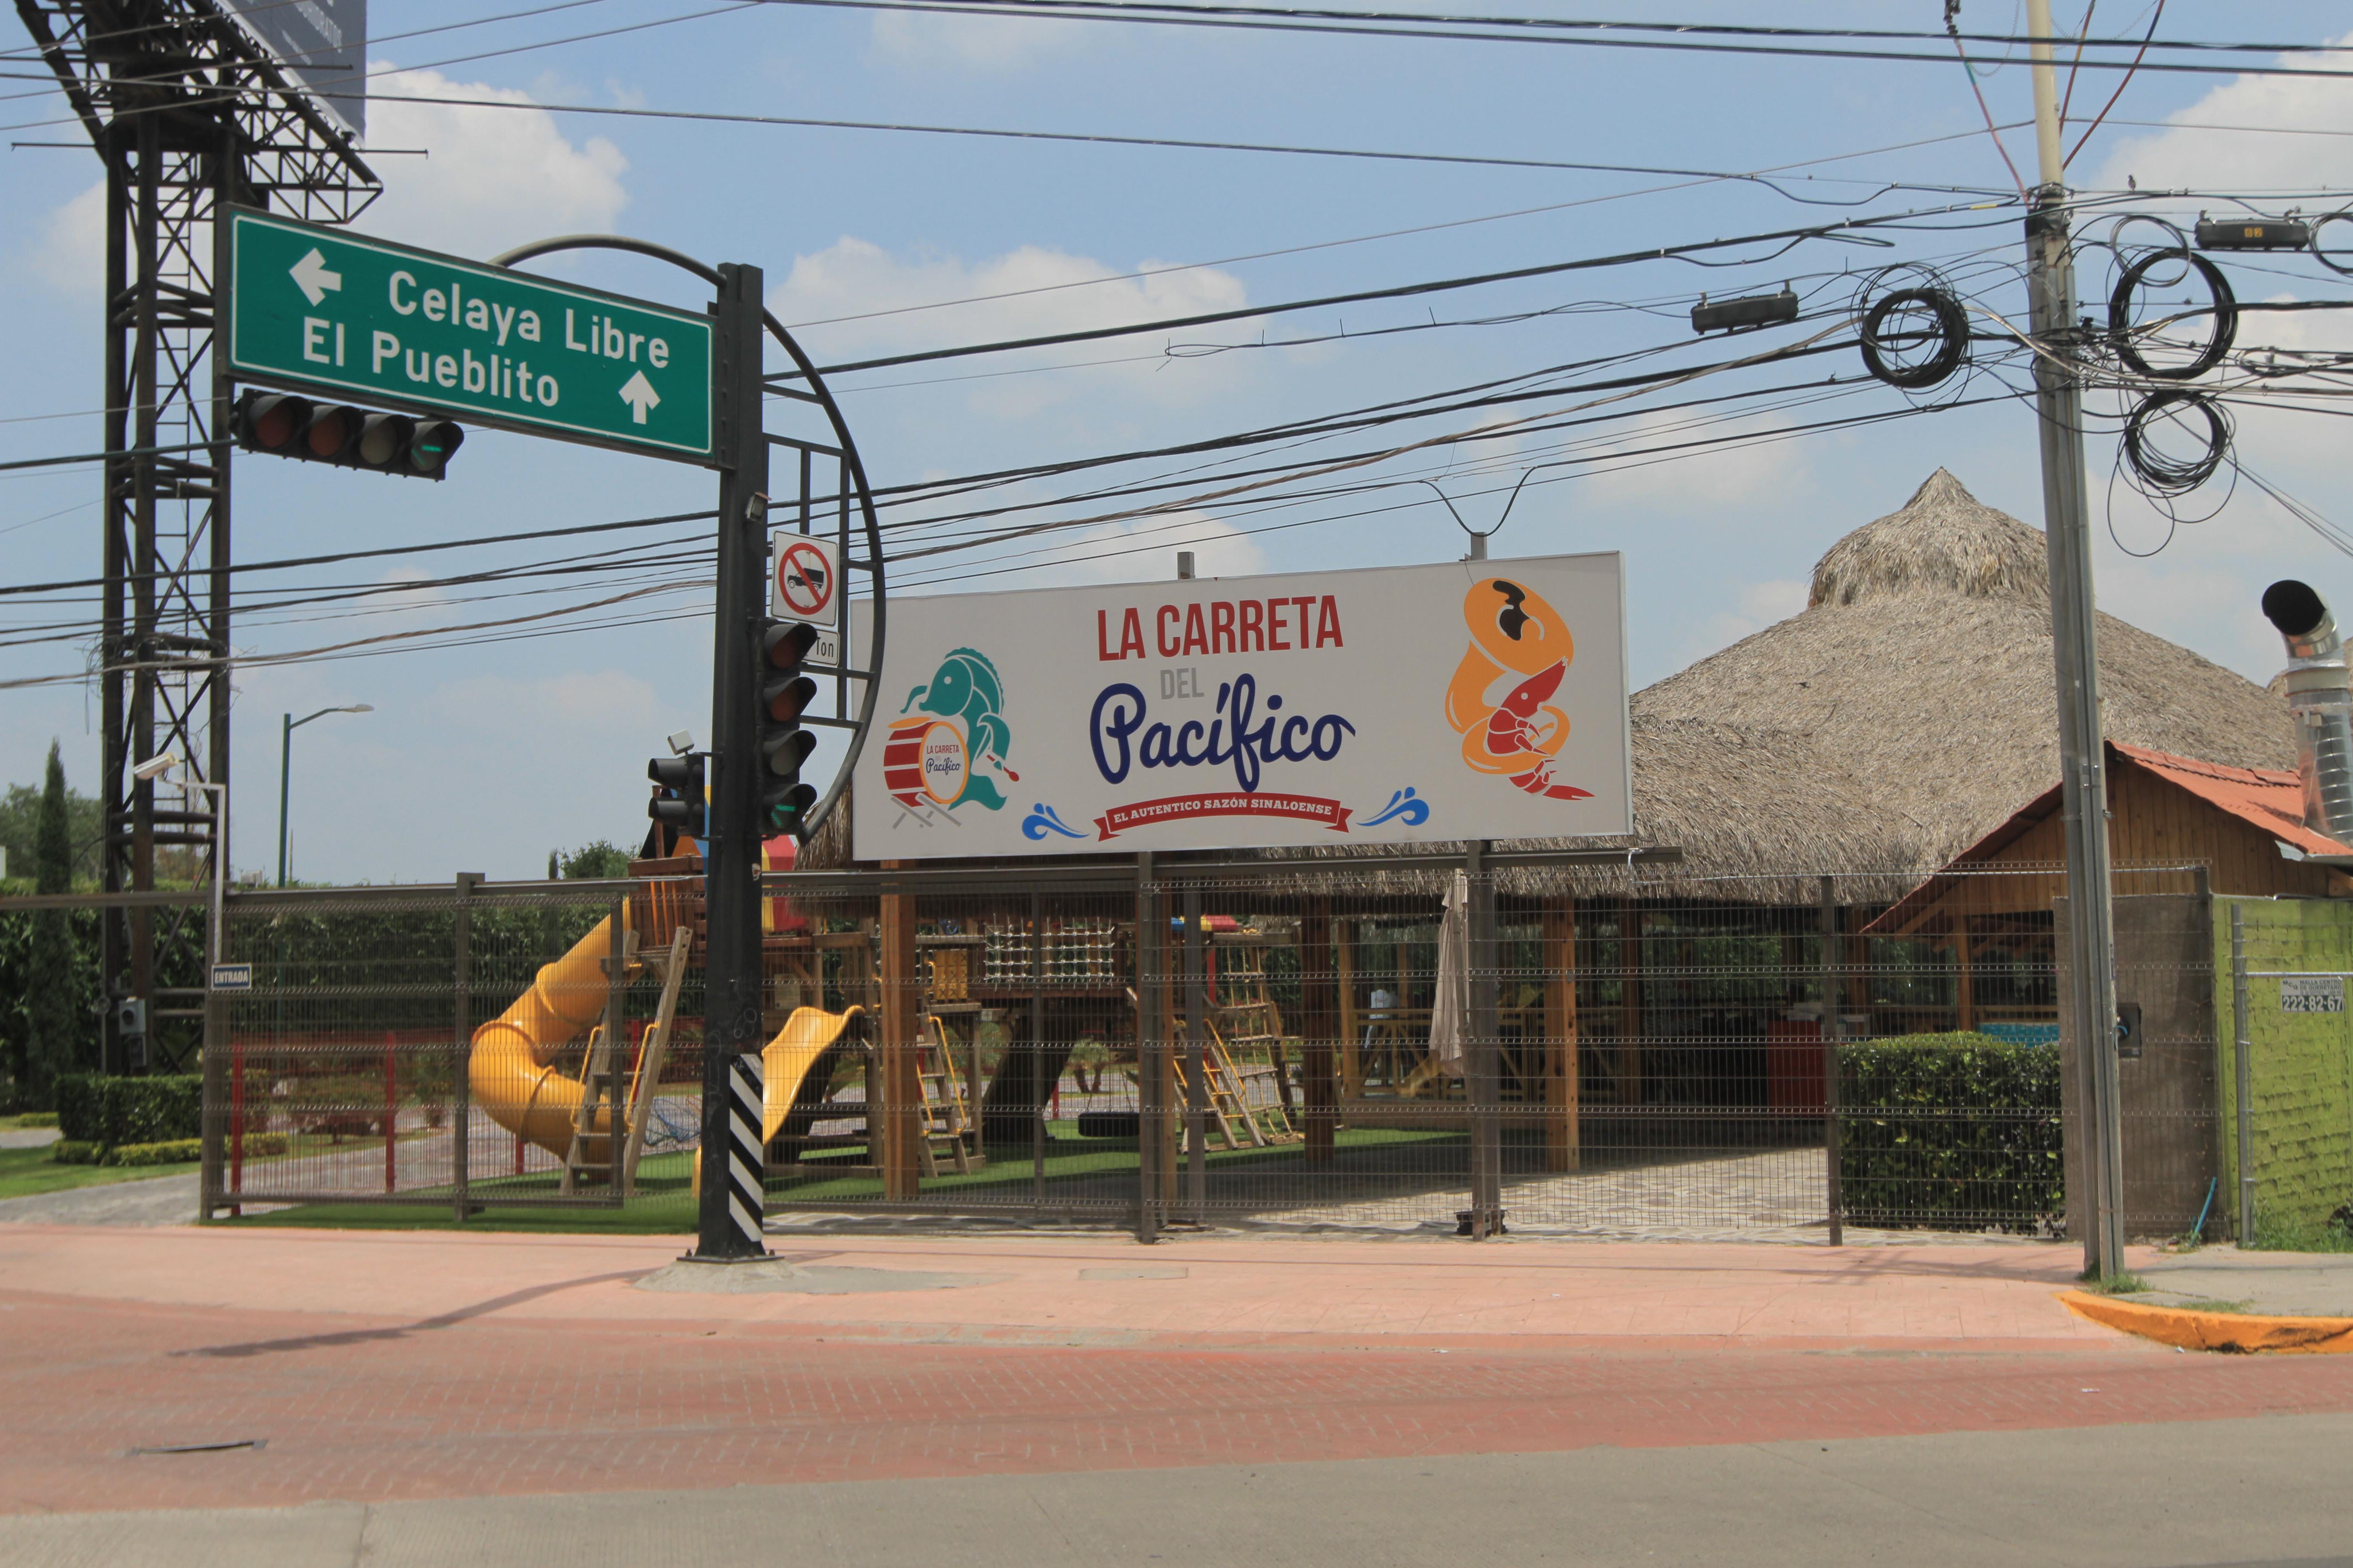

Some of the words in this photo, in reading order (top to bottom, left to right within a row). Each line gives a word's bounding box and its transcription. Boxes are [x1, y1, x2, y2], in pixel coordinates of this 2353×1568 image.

[389, 270, 541, 346] Celaya
[565, 308, 669, 369] Libre
[303, 316, 345, 367] El
[372, 330, 559, 407] Pueblito
[1098, 608, 1146, 661] LA
[1157, 595, 1343, 658] CARRETA
[817, 637, 834, 657] Ton
[1160, 667, 1205, 700] DEL
[1090, 673, 1356, 793] Pacífico
[927, 746, 934, 754] LA
[935, 745, 960, 753] CARRETA
[926, 757, 961, 775] Pacífico
[1113, 813, 1128, 823] EL
[1131, 800, 1201, 819] AUTENTICO
[1204, 797, 1247, 809] SAZÓN
[1251, 799, 1332, 815] SINALOENSE
[215, 971, 249, 984] ENTRADA
